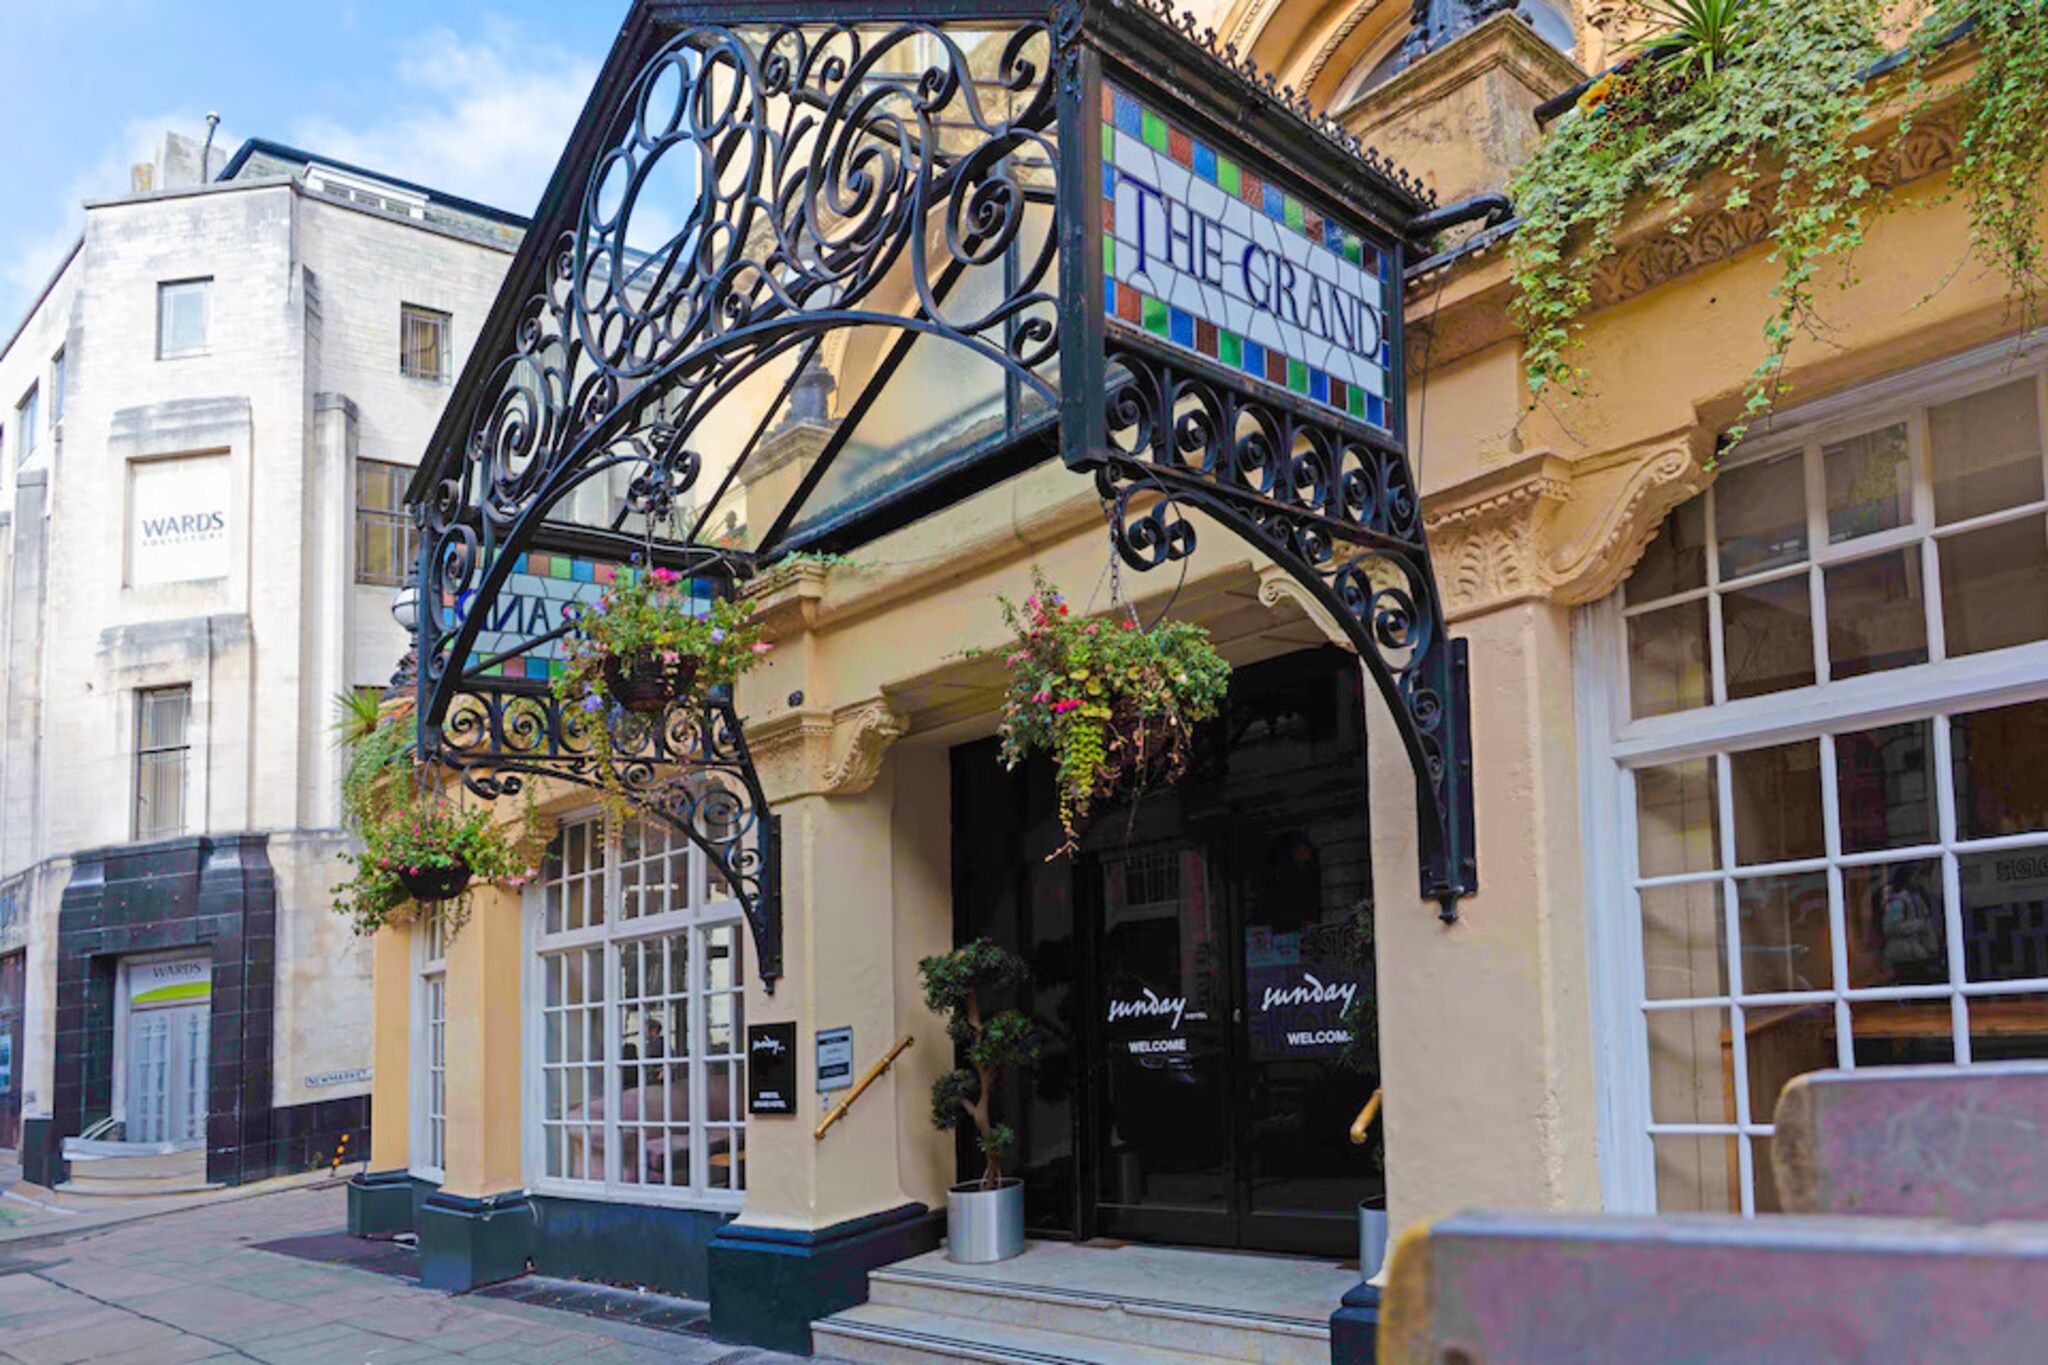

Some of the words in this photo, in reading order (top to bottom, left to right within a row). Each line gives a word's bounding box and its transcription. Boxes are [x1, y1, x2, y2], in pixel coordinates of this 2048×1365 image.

[1119, 173, 1223, 287] THE
[1242, 243, 1382, 359] GRAND
[142, 511, 224, 538] WARDS
[153, 963, 202, 978] WARDS
[1107, 987, 1186, 1030] sunday
[1261, 972, 1357, 1019] sunday
[1128, 1038, 1187, 1053] WELCOME
